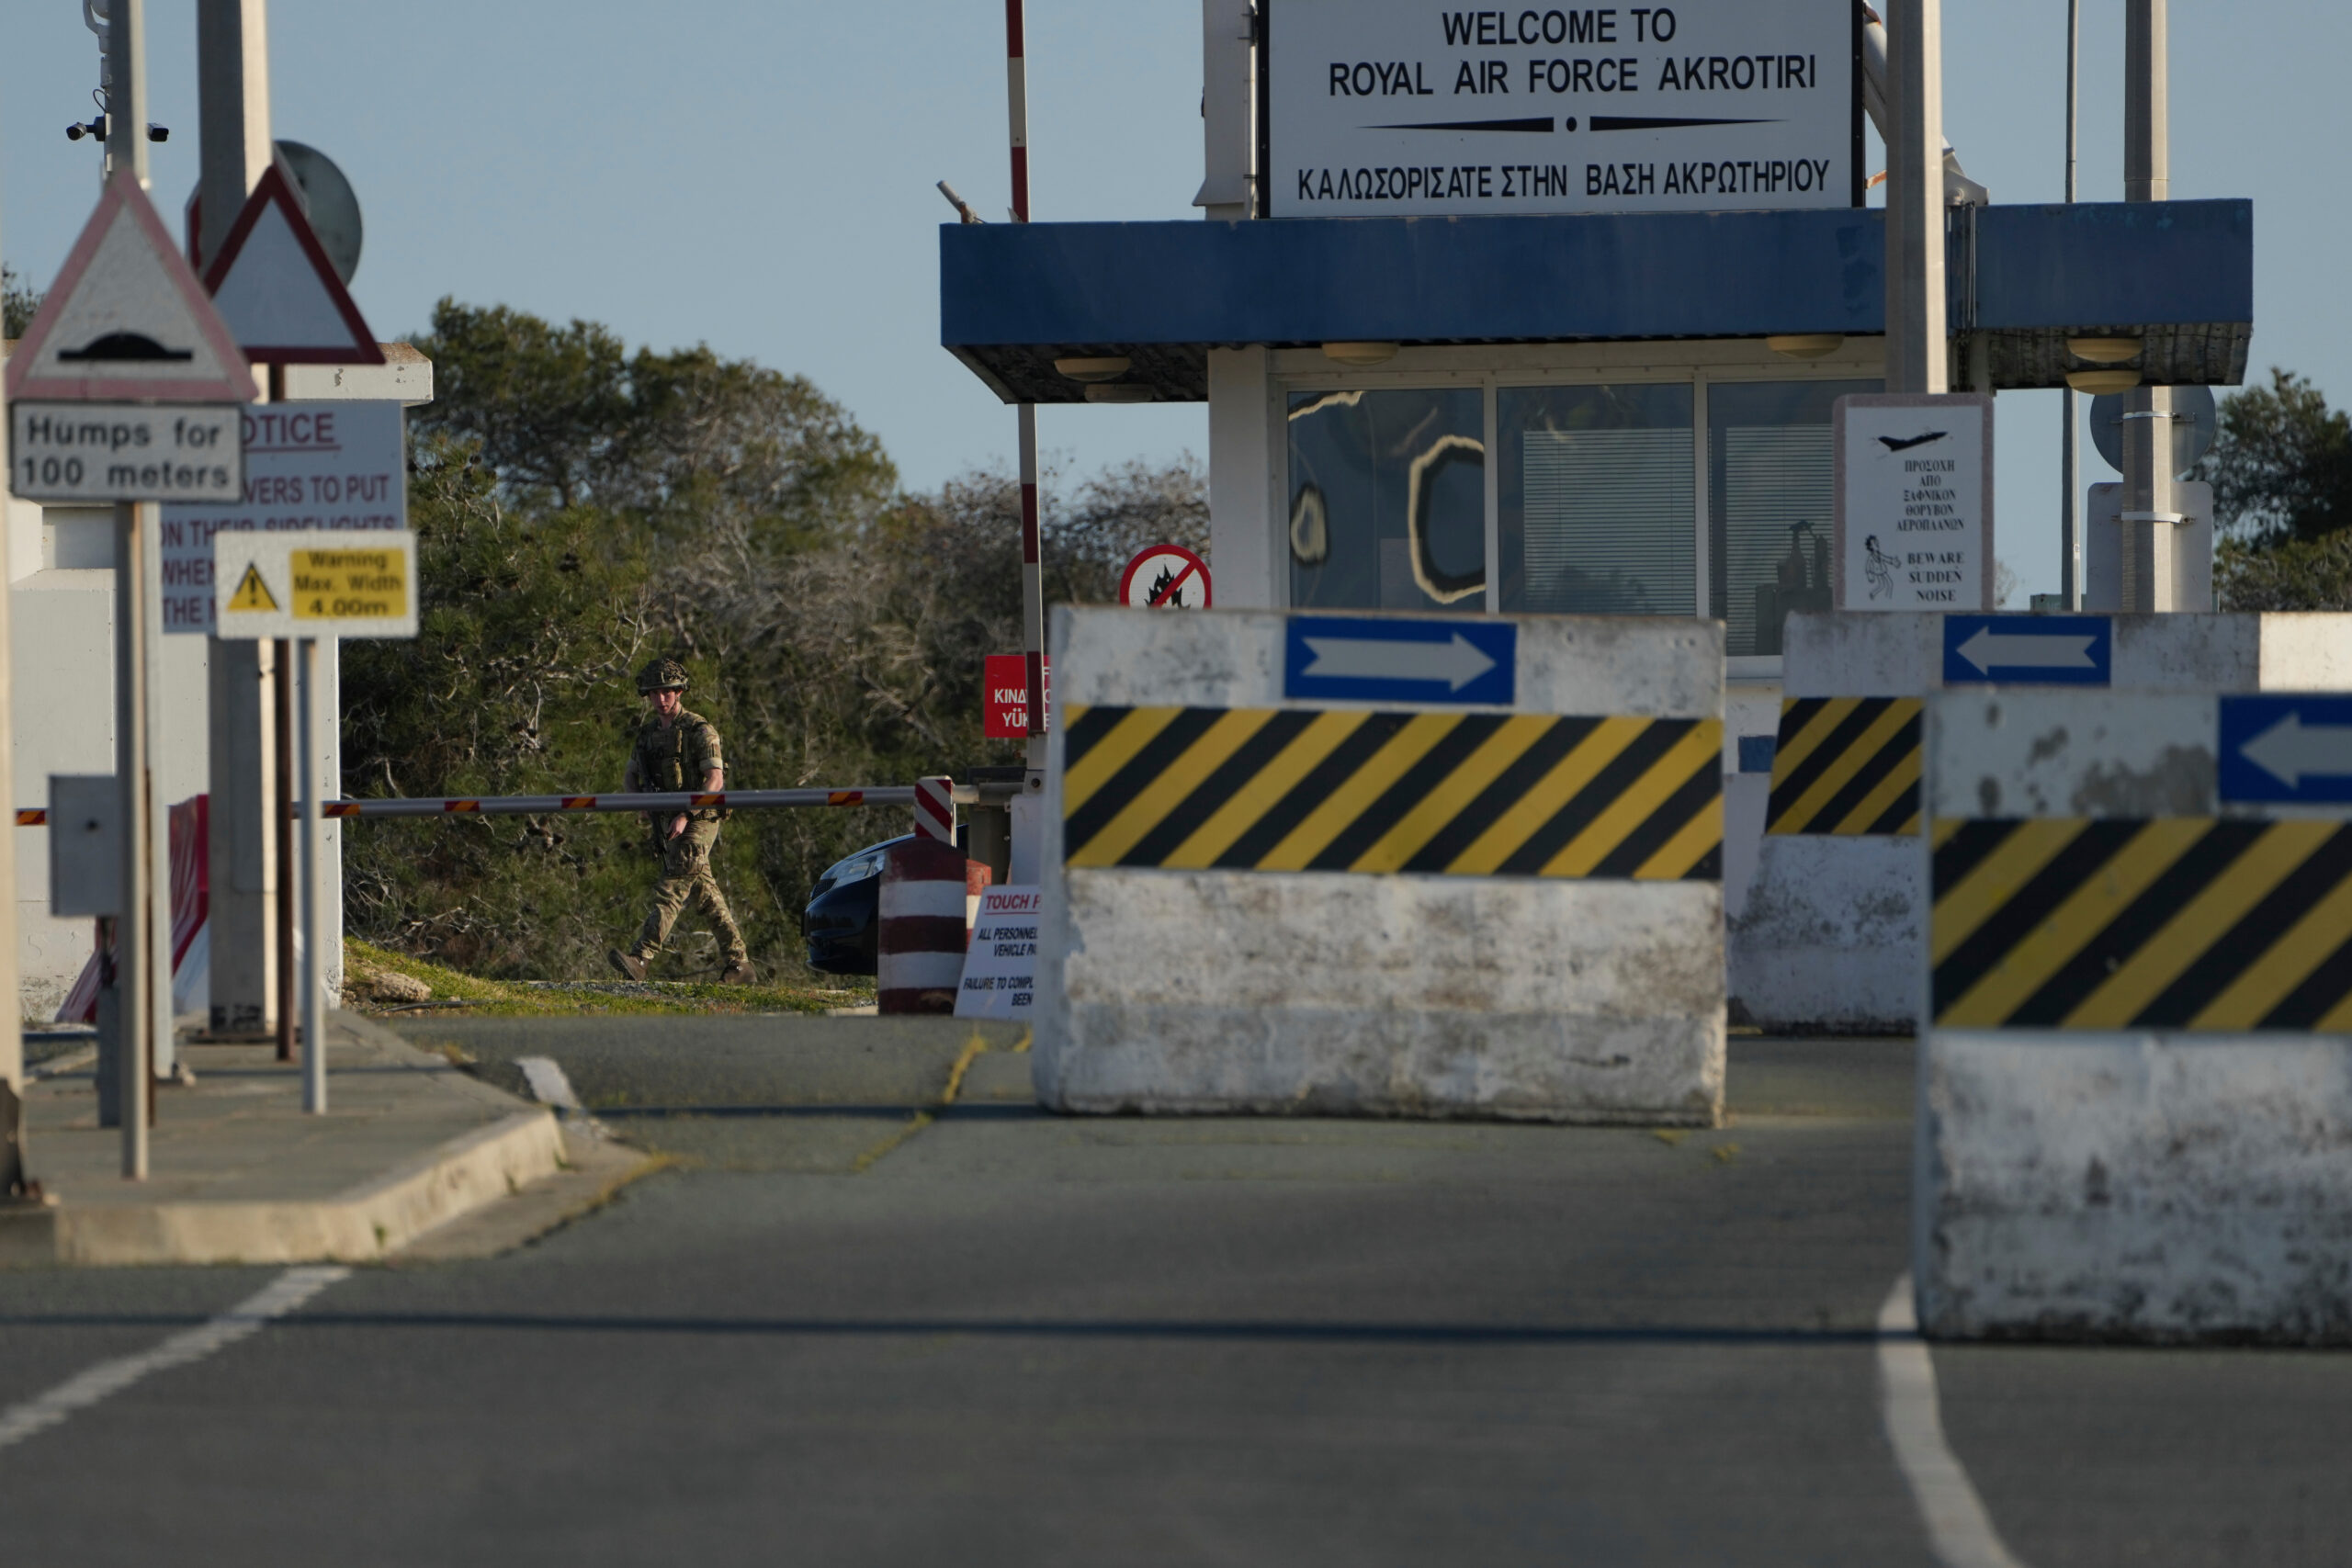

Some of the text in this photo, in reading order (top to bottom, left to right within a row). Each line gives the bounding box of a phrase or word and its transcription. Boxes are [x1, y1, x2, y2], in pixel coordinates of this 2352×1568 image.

[1442, 7, 1677, 46] WELCOME TO
[1329, 54, 1815, 96] ROYAL AIR FORCE AKROTIRI
[1298, 159, 1830, 200] ΚΑΛΩΣΟΡΙΣΑΤΕ ΣΤΗΝ ΒΑΣΗ ΑΚΡΩΤΗΡΙΟΥ
[27, 415, 220, 453] Humps for
[243, 412, 335, 445] OTICE
[23, 457, 229, 489] 100 meters
[1905, 459, 1955, 472] ΠΡΟΣΟΧΗ
[311, 476, 340, 503] TO
[346, 474, 390, 502] PUT
[1919, 475, 1941, 487] ΑΠΟ
[1904, 490, 1956, 502] ΞΑΦΝΙΚΟΝ
[1905, 504, 1954, 516] ΘΟΡΥΒΟΝ
[308, 551, 388, 571] Warning
[1907, 552, 1964, 565] BEWARE
[348, 574, 401, 592] Width
[1908, 570, 1962, 583] SUDDEN
[1916, 590, 1957, 602] NOISE
[309, 598, 390, 617] 4.00m
[986, 895, 1030, 910] TOUCH
[978, 928, 1037, 941] ALL PERSONNEL
[993, 944, 1024, 957] VEHICLE
[963, 976, 994, 990] FAILURE
[997, 976, 1007, 989] TO
